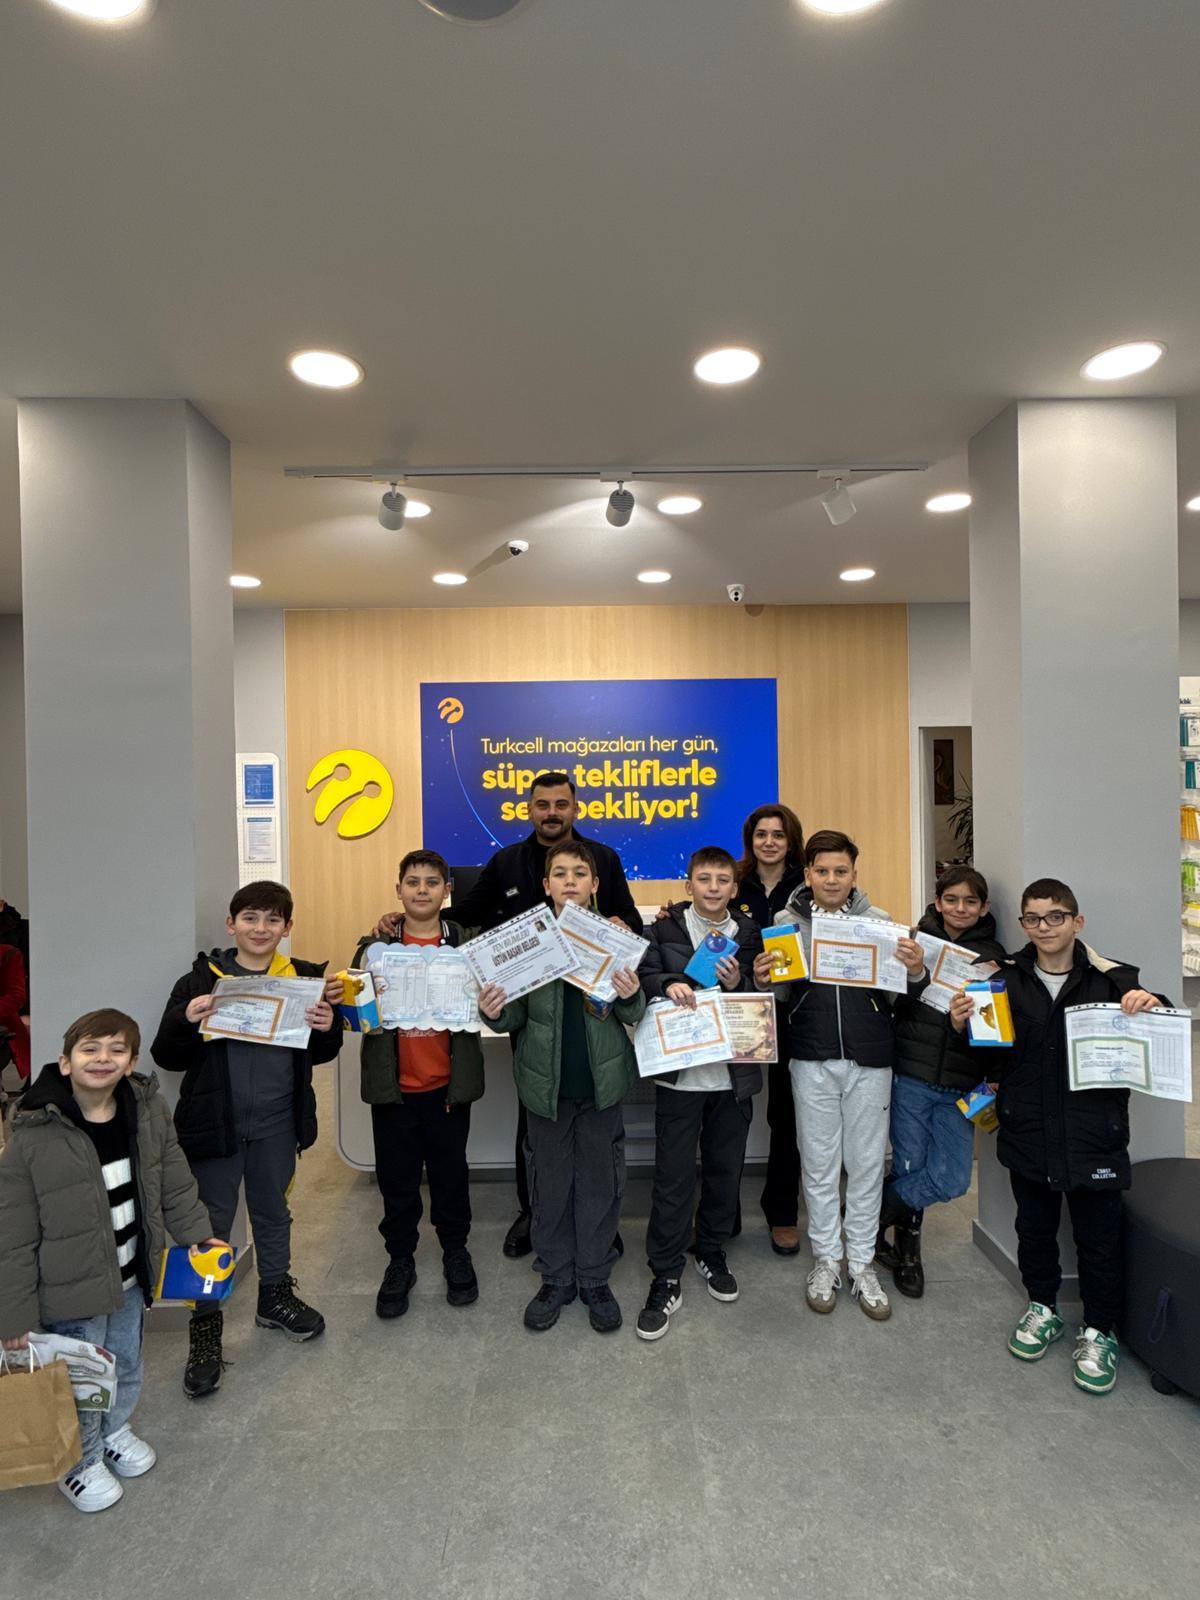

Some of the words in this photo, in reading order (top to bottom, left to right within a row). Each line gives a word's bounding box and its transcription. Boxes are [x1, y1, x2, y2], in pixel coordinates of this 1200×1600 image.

[480, 737, 543, 755] Turkcell
[548, 736, 646, 757] mağazaları
[650, 736, 678, 753] her
[682, 735, 718, 755] gün,
[482, 762, 568, 795] süp
[573, 759, 717, 788] tekliflerle
